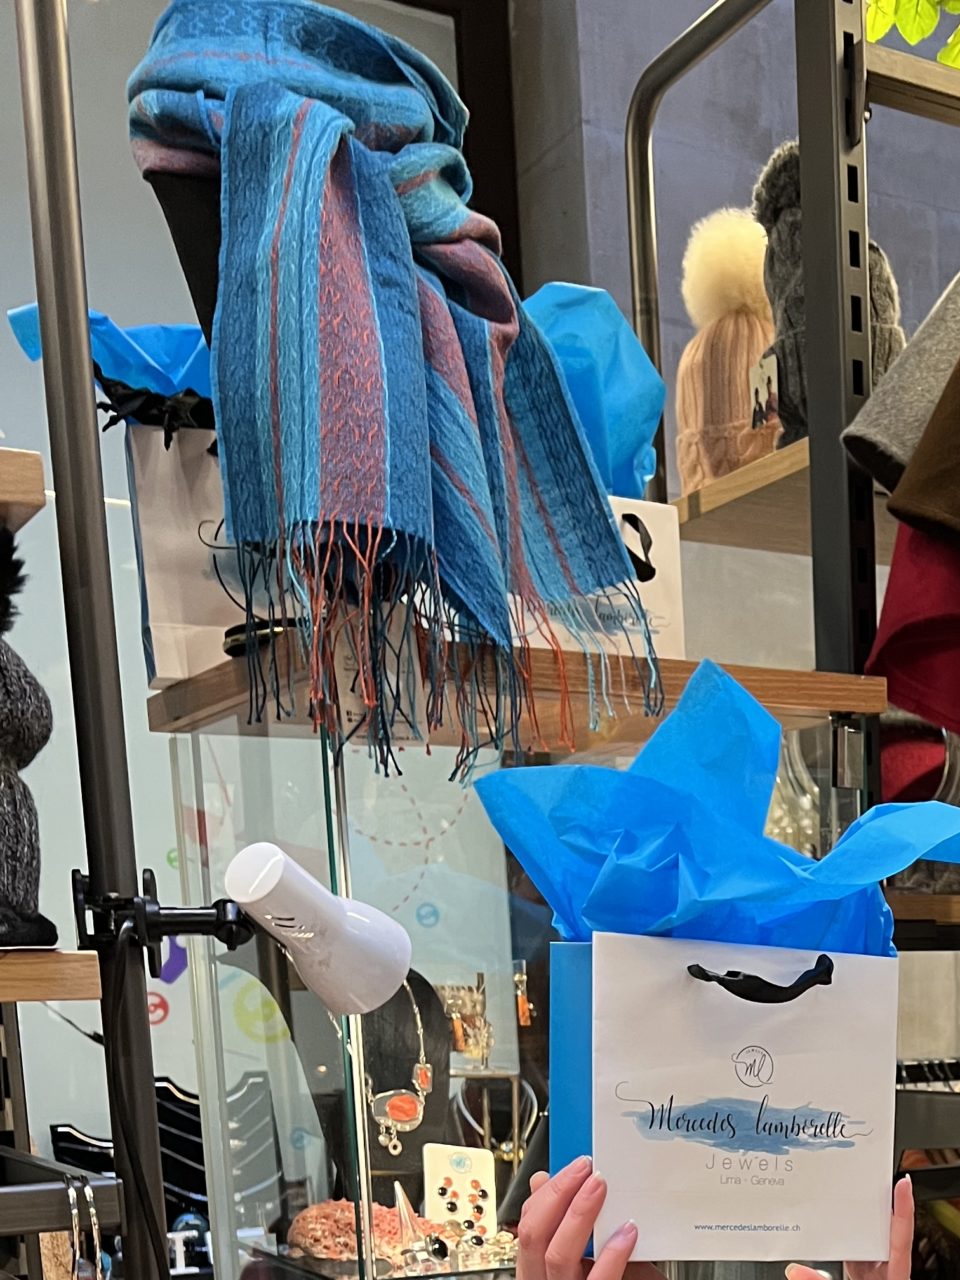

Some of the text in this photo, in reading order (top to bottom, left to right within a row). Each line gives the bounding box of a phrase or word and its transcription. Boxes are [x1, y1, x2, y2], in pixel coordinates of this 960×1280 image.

[705, 1153, 794, 1172] Jewels
[720, 1175, 741, 1185] Lima
[750, 1175, 785, 1186] Geneva
[694, 1223, 801, 1232] www.mercedeslamborelle.ch
